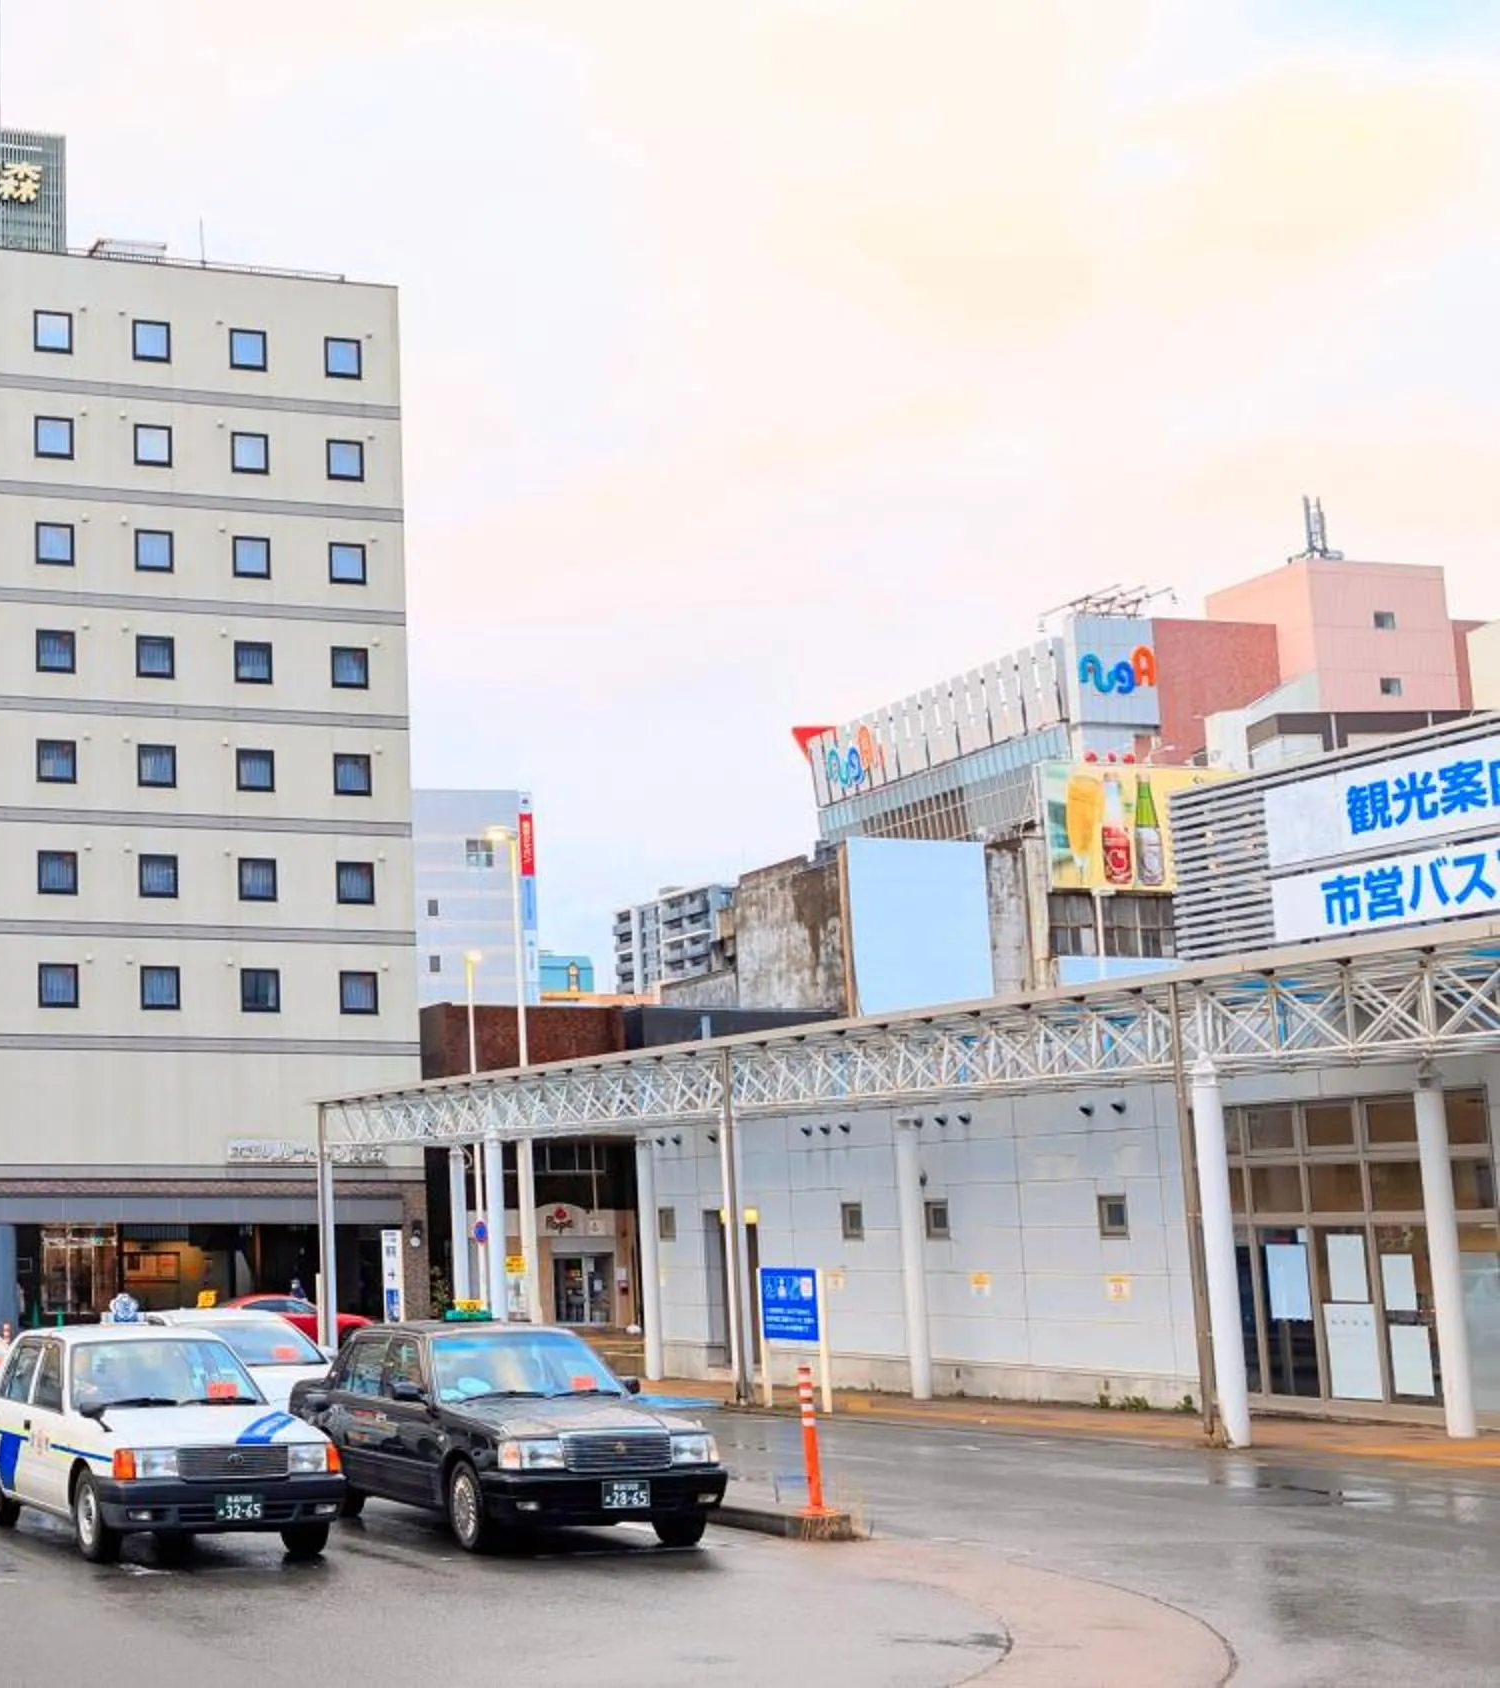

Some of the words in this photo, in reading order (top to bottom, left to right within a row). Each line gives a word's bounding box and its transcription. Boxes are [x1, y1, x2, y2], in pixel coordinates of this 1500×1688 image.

[1346, 759, 1500, 835] 観光案
[1320, 850, 1500, 926] 市営バス
